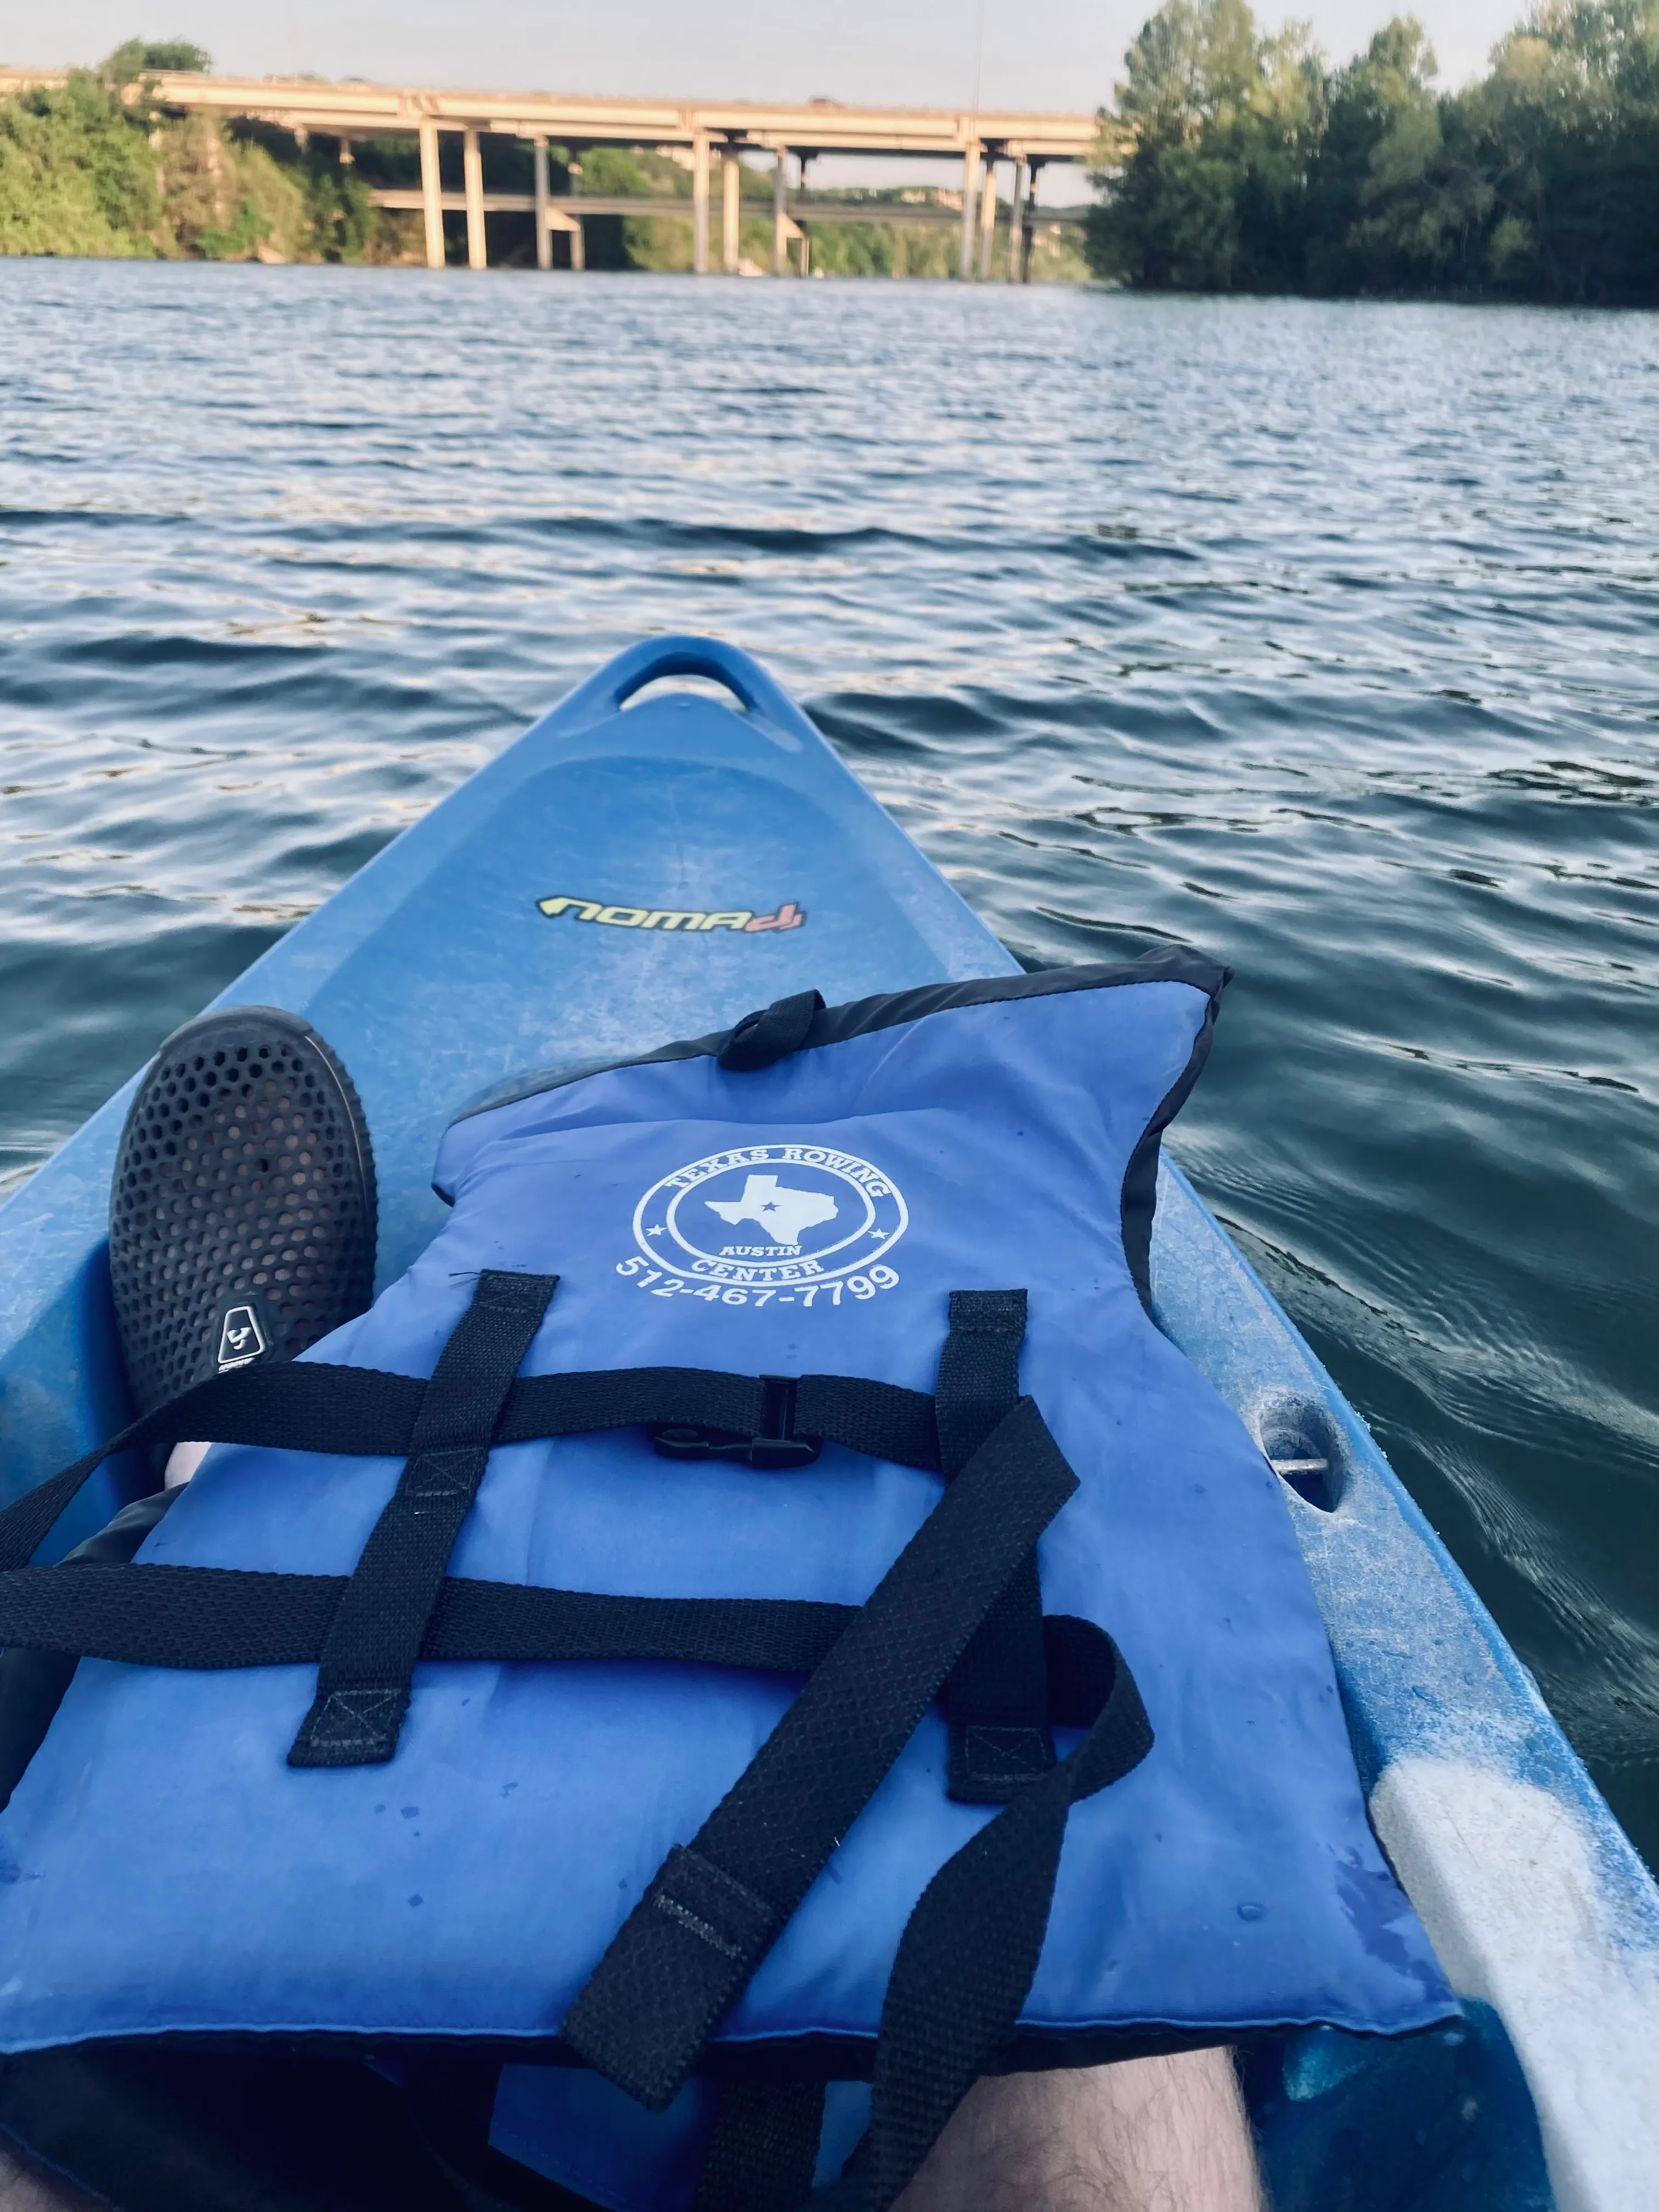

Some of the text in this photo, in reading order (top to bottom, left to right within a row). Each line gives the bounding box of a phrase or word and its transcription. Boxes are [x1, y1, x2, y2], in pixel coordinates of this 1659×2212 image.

[665, 1147, 891, 1199] TEXAS ROWING
[719, 1245, 803, 1257] AUSTIN
[616, 1256, 900, 1307] 512-467-7799
[691, 1259, 825, 1282] CENTER
